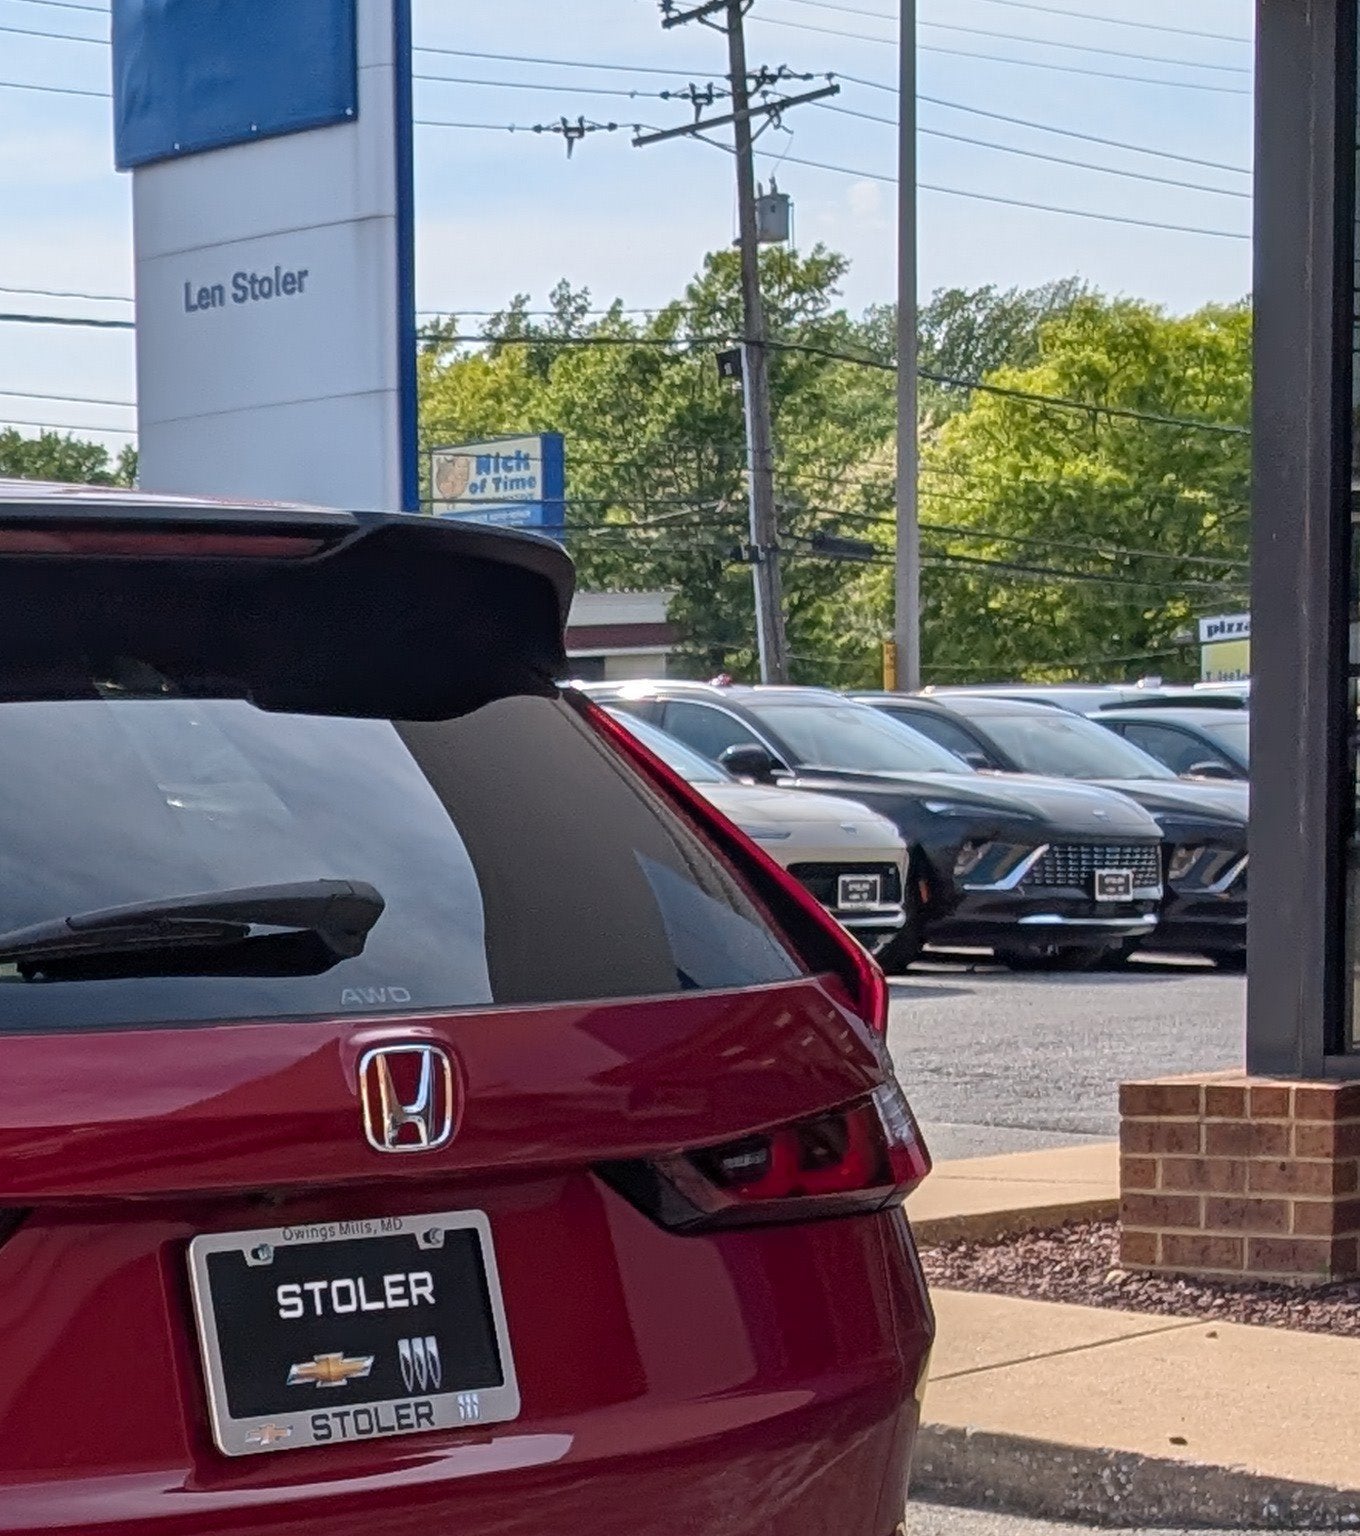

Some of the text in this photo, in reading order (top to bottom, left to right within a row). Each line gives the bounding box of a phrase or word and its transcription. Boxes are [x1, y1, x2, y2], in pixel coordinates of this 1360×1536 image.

[184, 265, 309, 313] Len Stoler
[469, 475, 537, 495] of Time
[340, 986, 411, 1006] AWD
[282, 1217, 403, 1242] Owings Mills, MD
[276, 1270, 437, 1320] STOLER
[310, 1401, 436, 1442] STOLER
